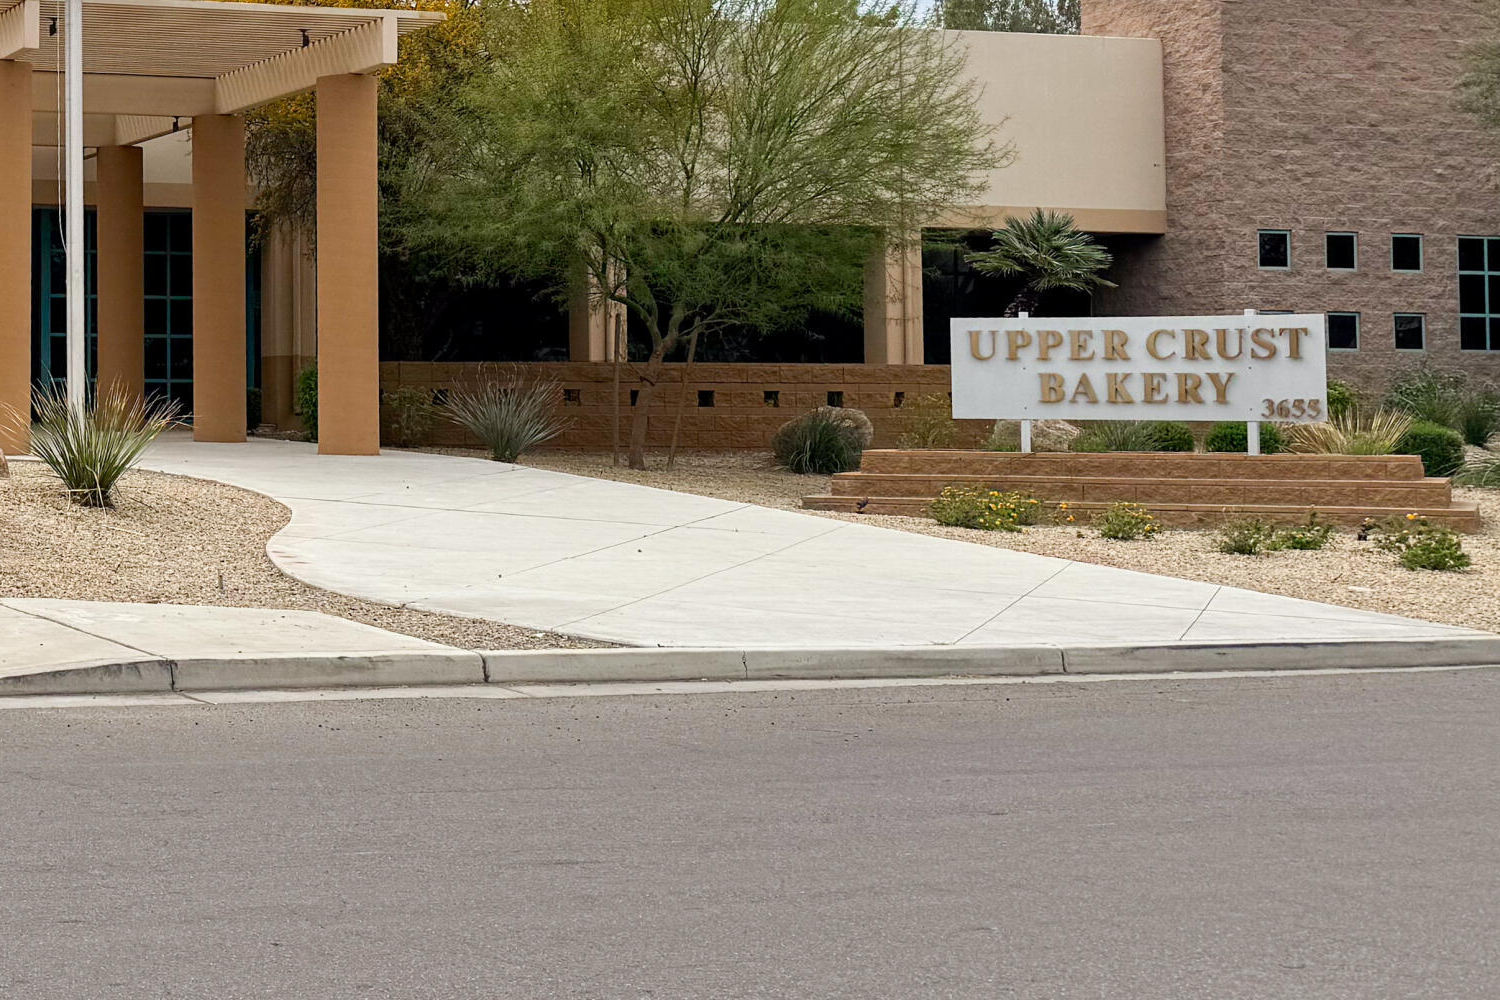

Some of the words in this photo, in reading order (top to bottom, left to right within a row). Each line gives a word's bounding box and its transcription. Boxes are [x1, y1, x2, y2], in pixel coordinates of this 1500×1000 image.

[968, 329, 1131, 361] UPPER
[1145, 326, 1309, 361] CRUST
[1038, 372, 1236, 405] BAKERY
[1261, 398, 1322, 419] 3655
